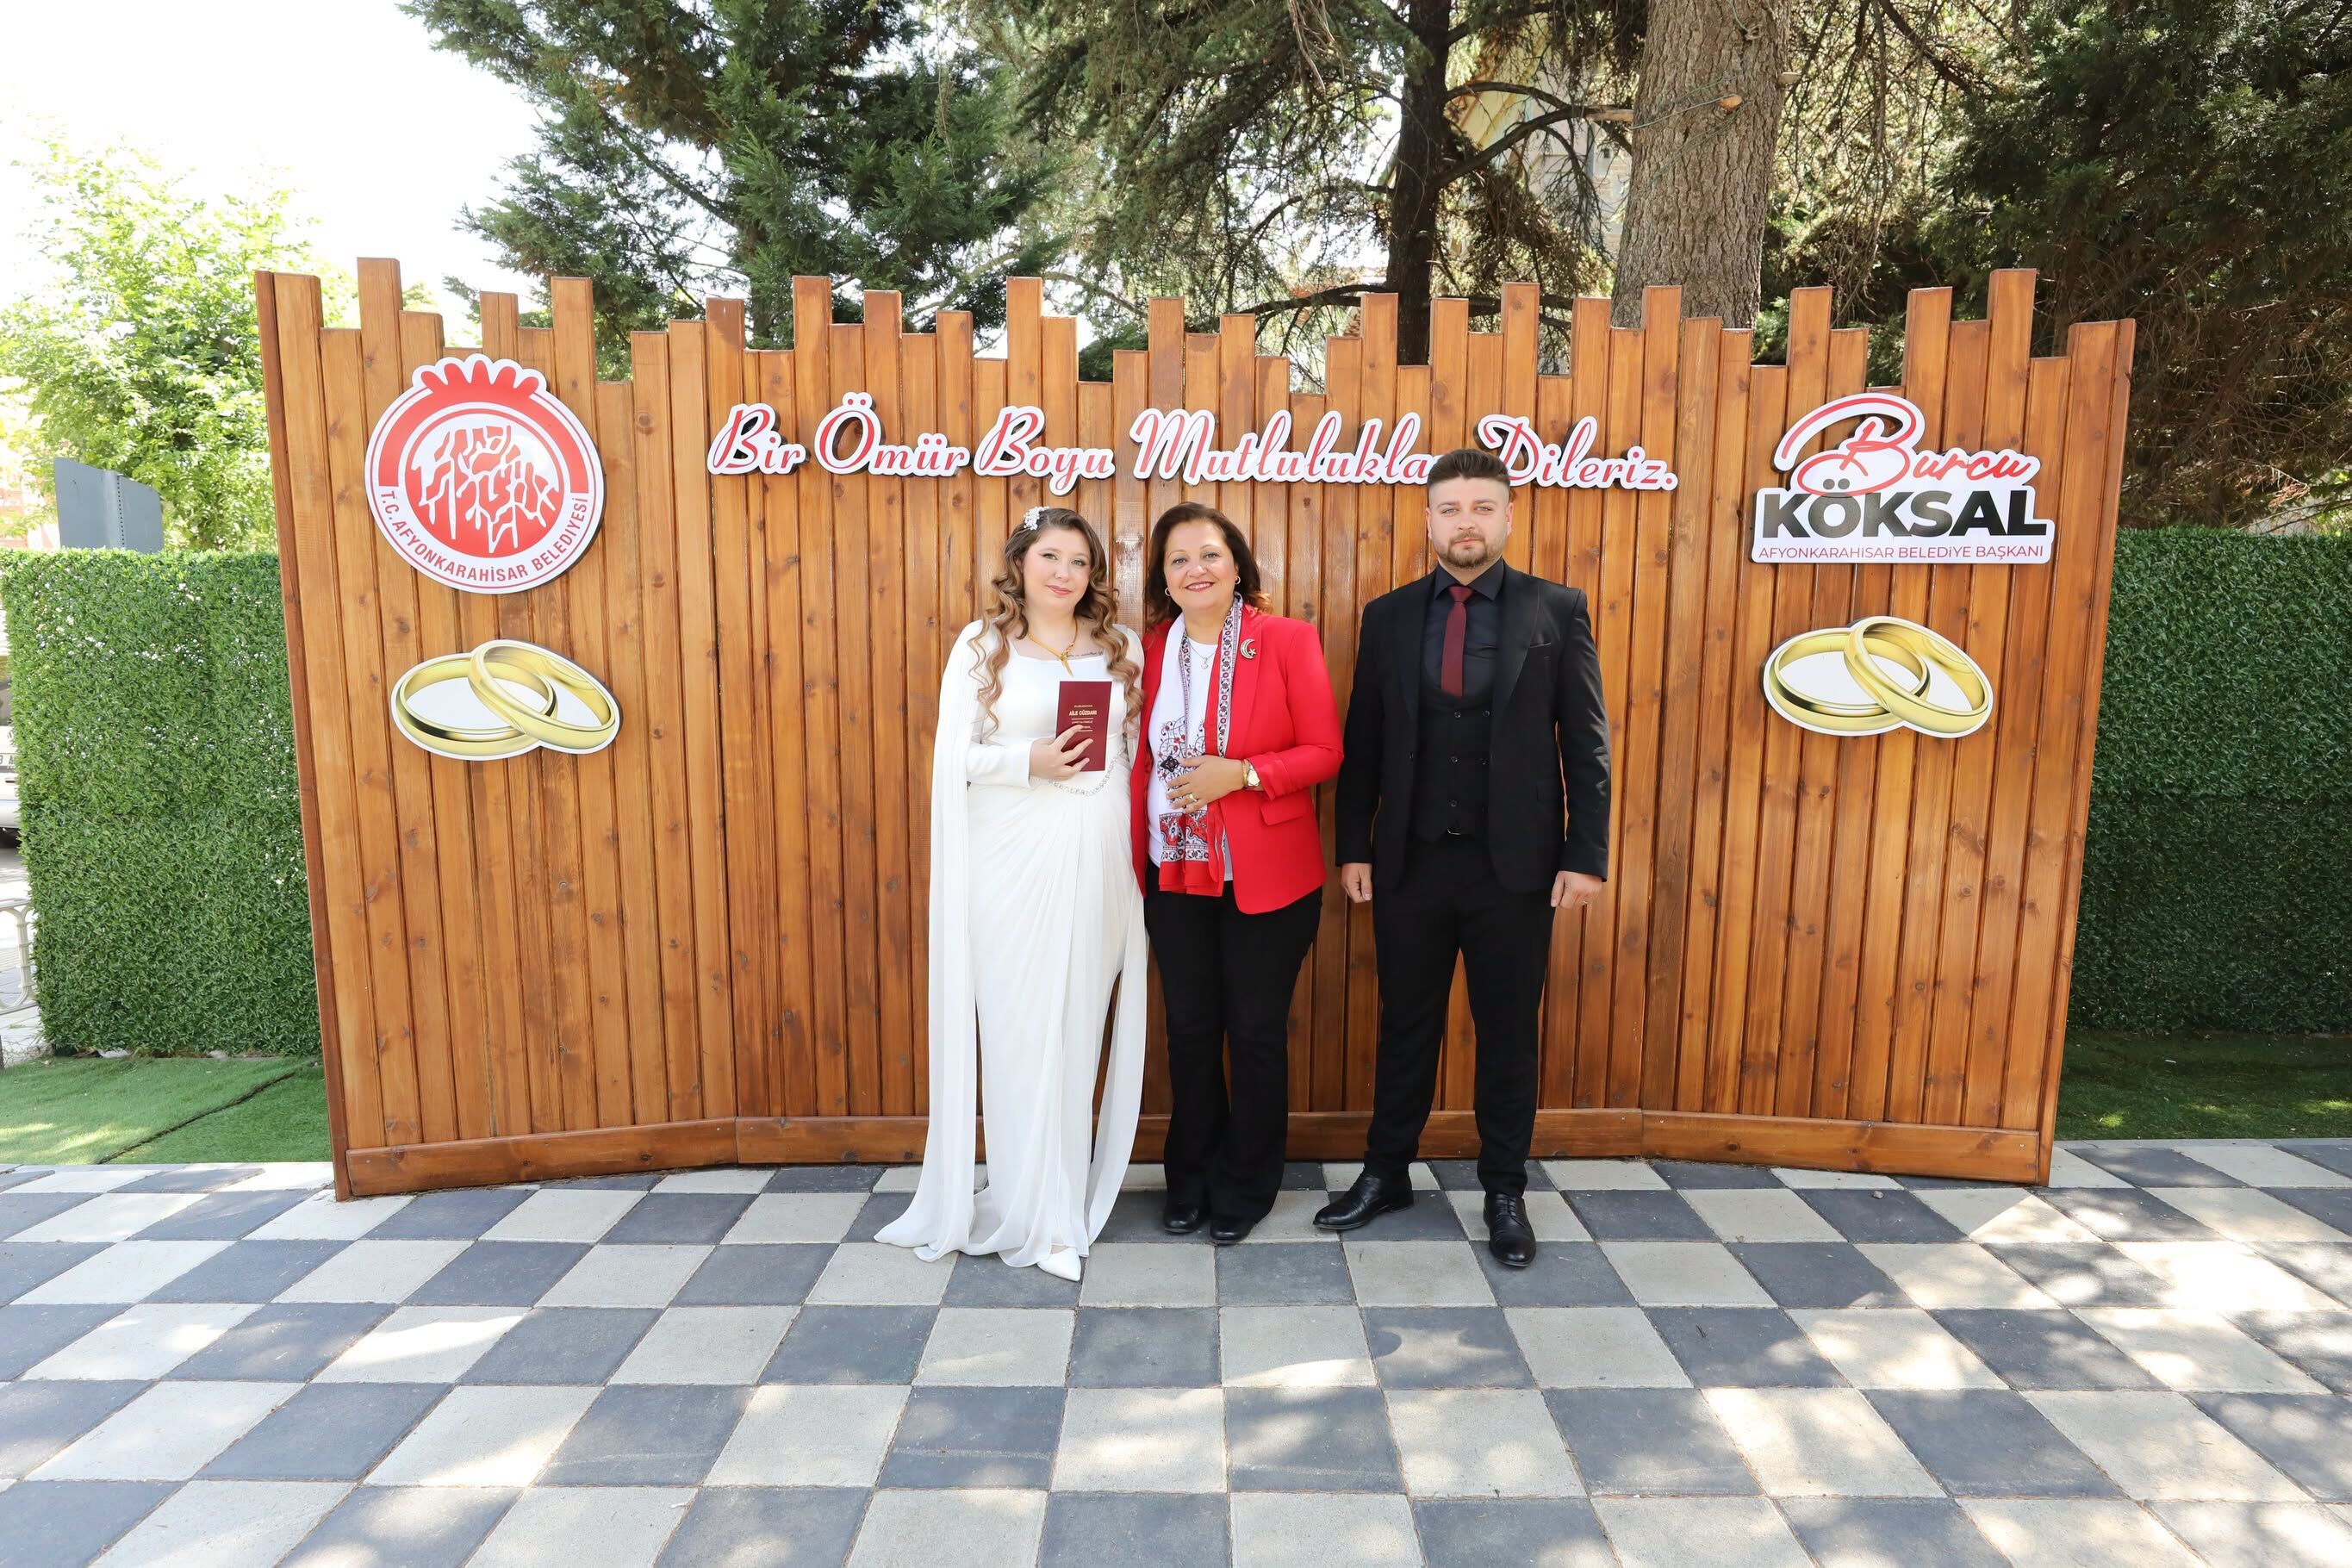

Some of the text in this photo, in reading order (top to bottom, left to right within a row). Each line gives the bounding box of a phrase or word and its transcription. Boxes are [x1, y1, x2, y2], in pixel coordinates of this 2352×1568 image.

[712, 399, 1674, 491] Bir Ömür Boyu Mutlulukla Dileriz.
[1781, 397, 2032, 496] Burcu
[1762, 477, 2047, 538] KÖKSAL
[1976, 545, 2044, 560] BAŞKANI
